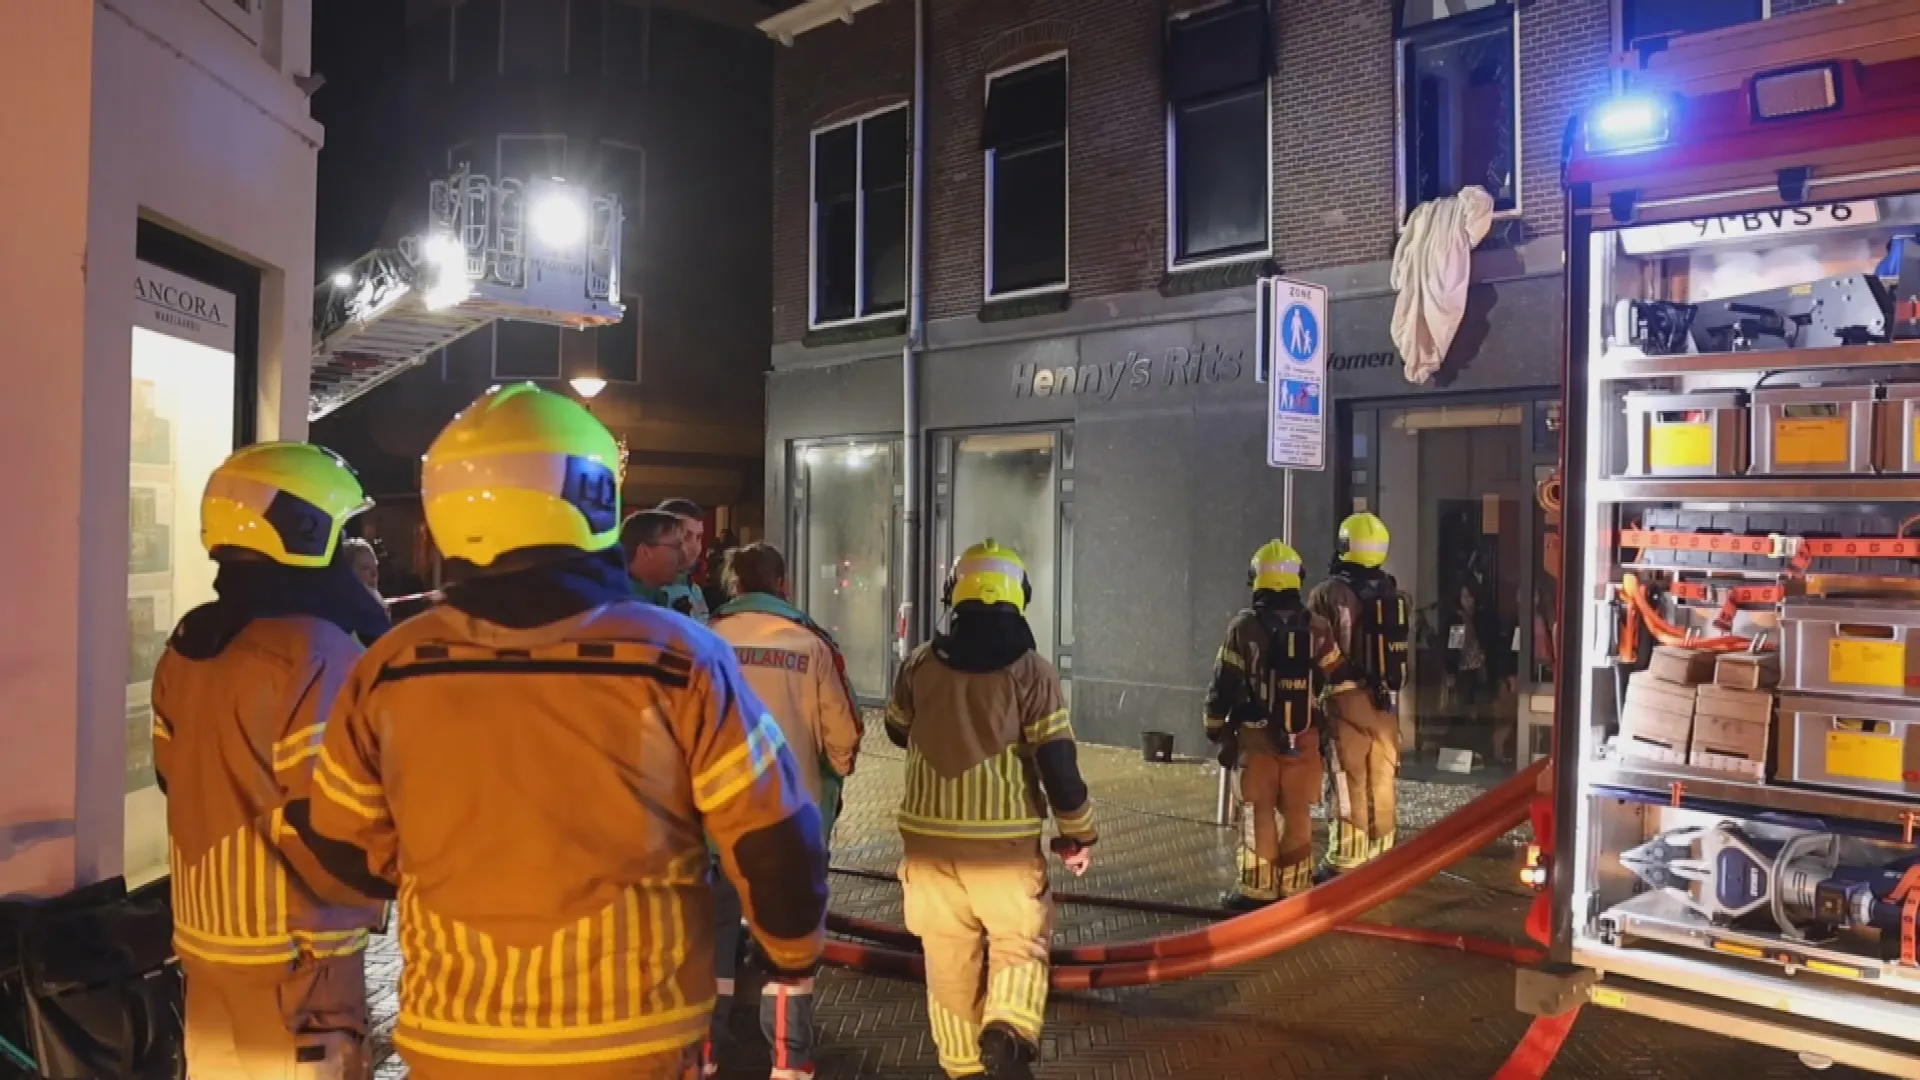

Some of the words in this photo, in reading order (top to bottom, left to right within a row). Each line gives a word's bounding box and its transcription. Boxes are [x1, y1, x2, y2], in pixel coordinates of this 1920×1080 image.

[135, 276, 221, 322] ANCORA
[1289, 286, 1313, 300] ZONE
[1326, 352, 1395, 371] omen
[1012, 352, 1152, 401] Henny's
[734, 646, 810, 675] ULANCE
